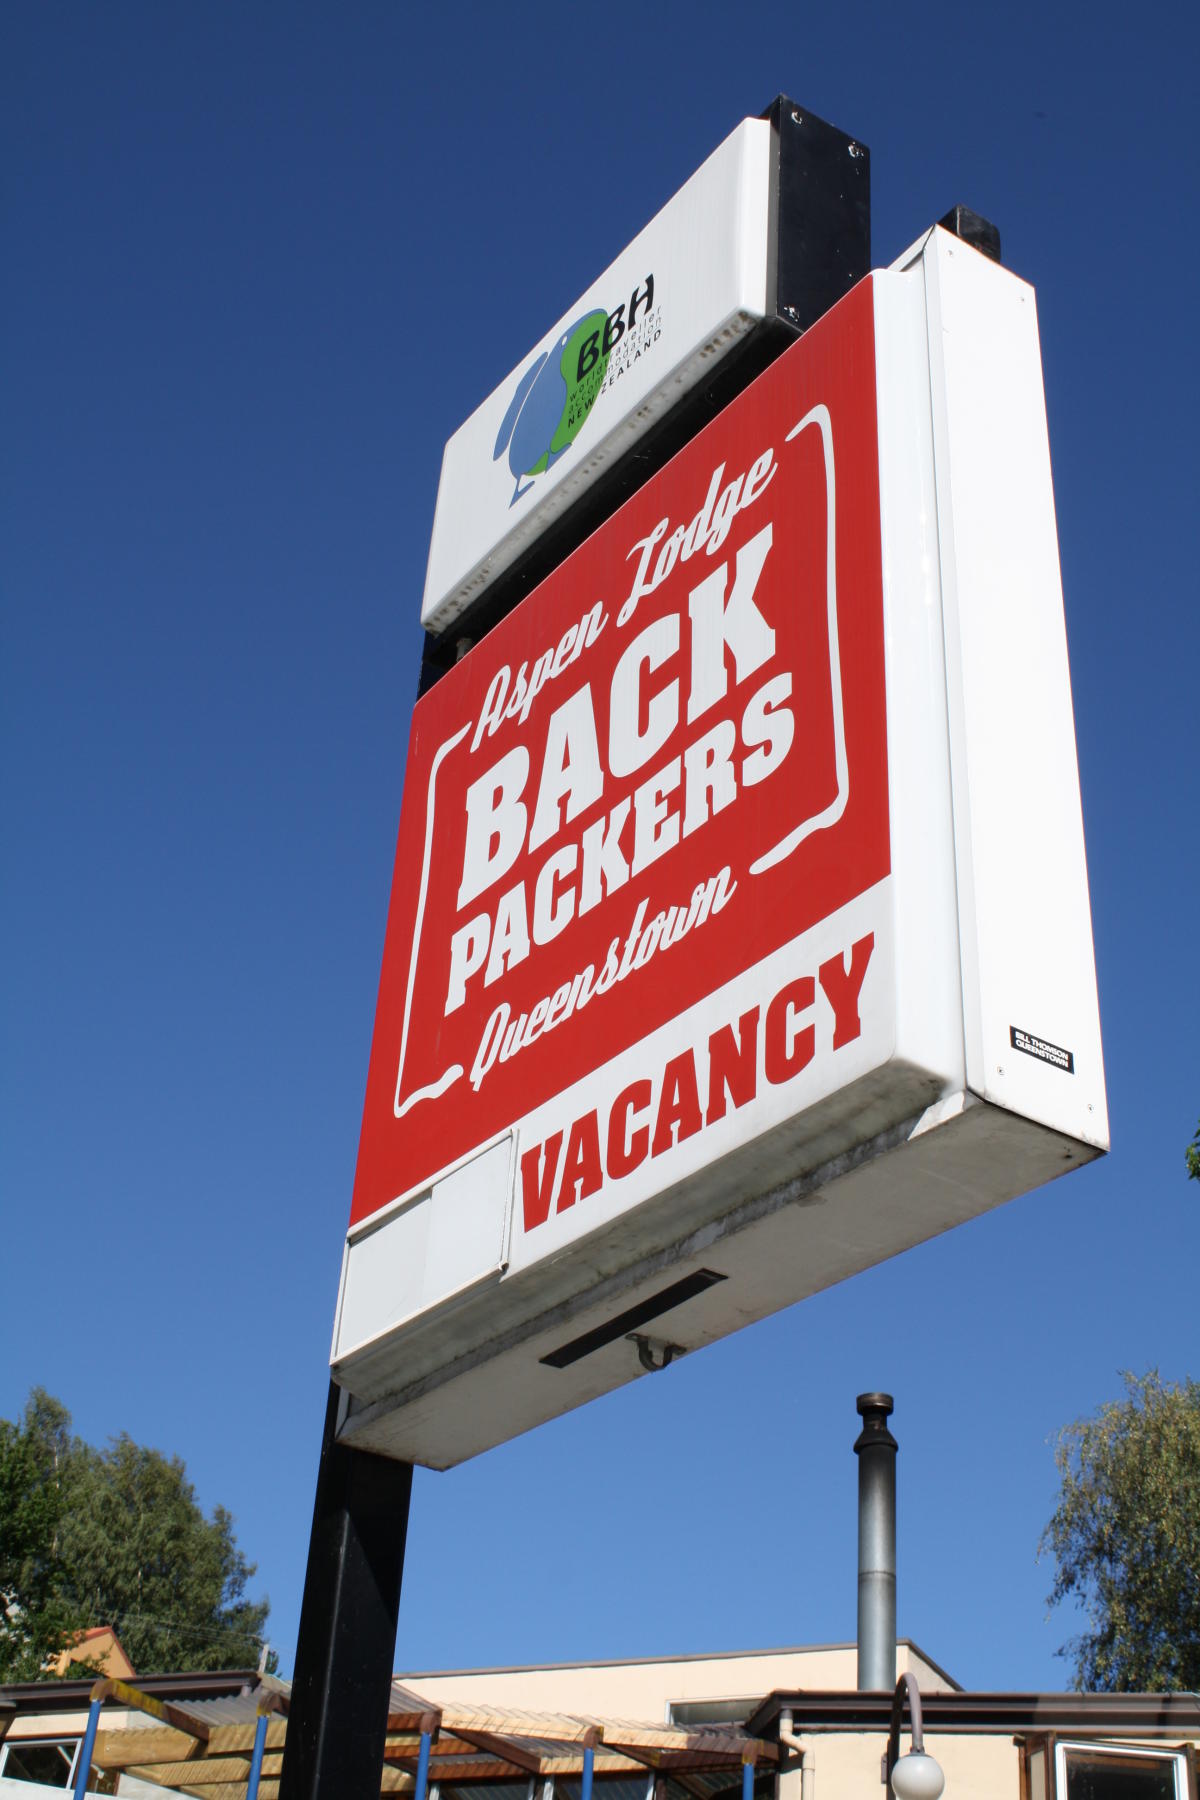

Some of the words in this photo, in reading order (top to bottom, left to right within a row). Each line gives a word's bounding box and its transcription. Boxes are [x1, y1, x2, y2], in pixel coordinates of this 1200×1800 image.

[568, 395, 595, 428] NEW
[601, 329, 661, 394] ZEALAND
[569, 317, 663, 415] accommodation
[577, 274, 654, 382] BBH
[470, 601, 609, 753] Aspen
[617, 448, 778, 627] Lodge
[457, 522, 775, 912] BACK
[444, 672, 794, 1017] PACKERS
[470, 863, 737, 1092] Queenstown
[1015, 1039, 1069, 1068] QUEENSTOWN
[1031, 1037, 1069, 1060] THOMSON
[521, 932, 874, 1232] VACANCY
